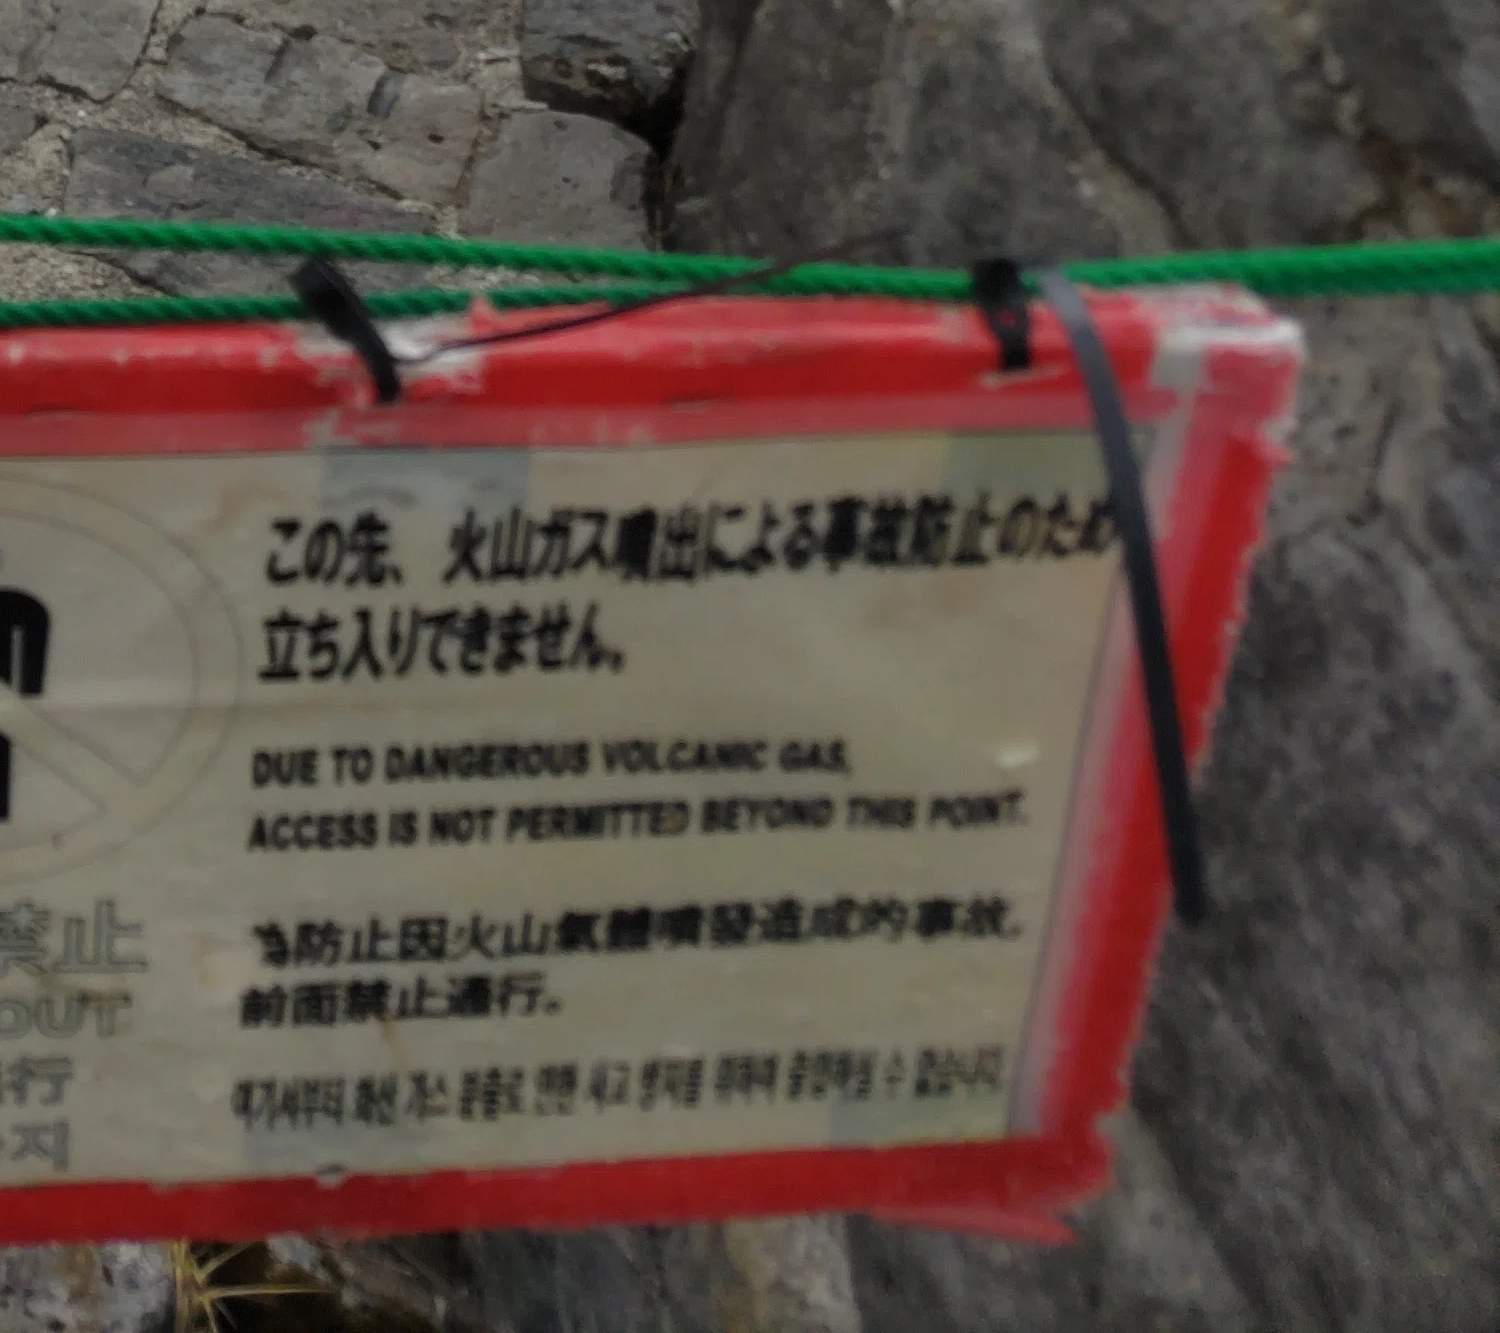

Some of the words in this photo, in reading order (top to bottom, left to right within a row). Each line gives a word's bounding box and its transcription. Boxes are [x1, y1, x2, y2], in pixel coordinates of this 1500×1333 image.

[257, 602, 624, 683] 立ち入りできません。
[251, 747, 318, 788] DUE
[332, 745, 375, 785] TO
[384, 739, 591, 783] DANGEROUS
[602, 736, 768, 779] VOLCANIC
[248, 810, 378, 851] ACCESS
[388, 808, 419, 848] IS
[428, 805, 495, 846] NOT
[505, 797, 690, 844] PERMITTED
[702, 794, 834, 833] BEYOND
[847, 793, 916, 830] THIS
